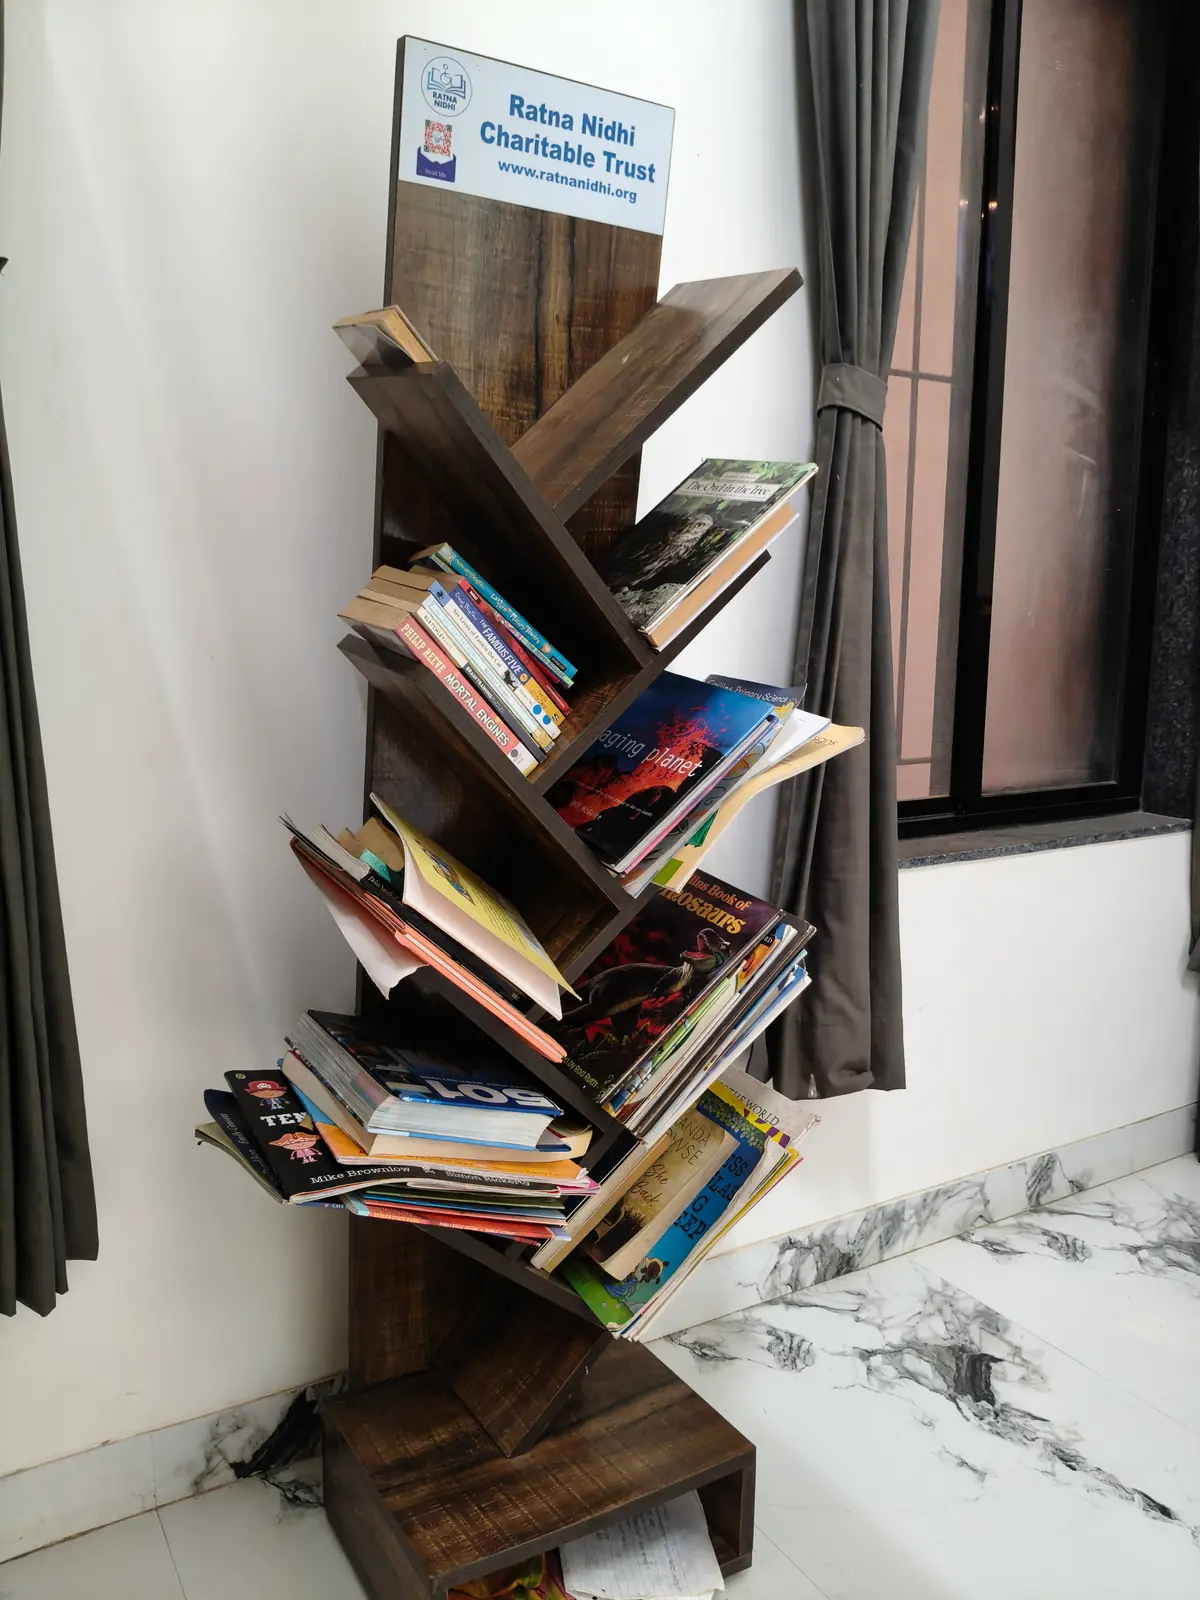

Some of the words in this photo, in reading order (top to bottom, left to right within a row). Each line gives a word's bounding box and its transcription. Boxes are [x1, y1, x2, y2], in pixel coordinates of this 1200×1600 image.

[432, 91, 458, 105] RATNA
[434, 100, 456, 112] NIDHI
[509, 94, 574, 131] Ratna
[581, 113, 636, 147] Nidhi
[480, 121, 596, 168] Charitable
[602, 150, 656, 184] Trust
[425, 168, 438, 177] Read
[498, 160, 638, 204] www.ratnanidhi.org
[687, 480, 704, 491] The
[703, 482, 727, 492] Owl
[725, 484, 735, 494] in
[733, 484, 751, 495] the
[750, 486, 771, 496] Tree
[455, 592, 466, 609] Enid
[464, 602, 478, 621] Blyton
[423, 614, 446, 641] BLETCHLEY
[453, 608, 462, 618] Six
[459, 616, 472, 631] Lives
[469, 628, 477, 637] of
[487, 650, 496, 661] the
[494, 657, 503, 669] Cat
[479, 619, 489, 630] THE
[524, 625, 541, 645] Towers
[482, 627, 509, 659] FAMOUS
[505, 654, 524, 676] FIVE
[400, 623, 426, 651] PHILIP
[422, 647, 447, 675] REEVE
[444, 672, 478, 711] MORTAL
[476, 708, 510, 747] ENGINES
[734, 685, 763, 700] Primary
[761, 692, 789, 703] Science
[599, 729, 647, 758] aging
[641, 747, 703, 777] planet
[707, 884, 737, 906] Book
[735, 899, 753, 912] of
[567, 1059, 577, 1071] by
[573, 1064, 588, 1078] Rod
[583, 1072, 599, 1088] Ruth
[424, 1079, 556, 1108] 501
[746, 1099, 781, 1127] WORLD
[309, 1172, 345, 1184] Mike
[347, 1166, 411, 1178] Brownlow
[444, 1171, 482, 1182] Simon
[482, 1175, 531, 1187] Rickerty
[644, 1163, 669, 1185] She
[629, 1180, 663, 1208] Back
